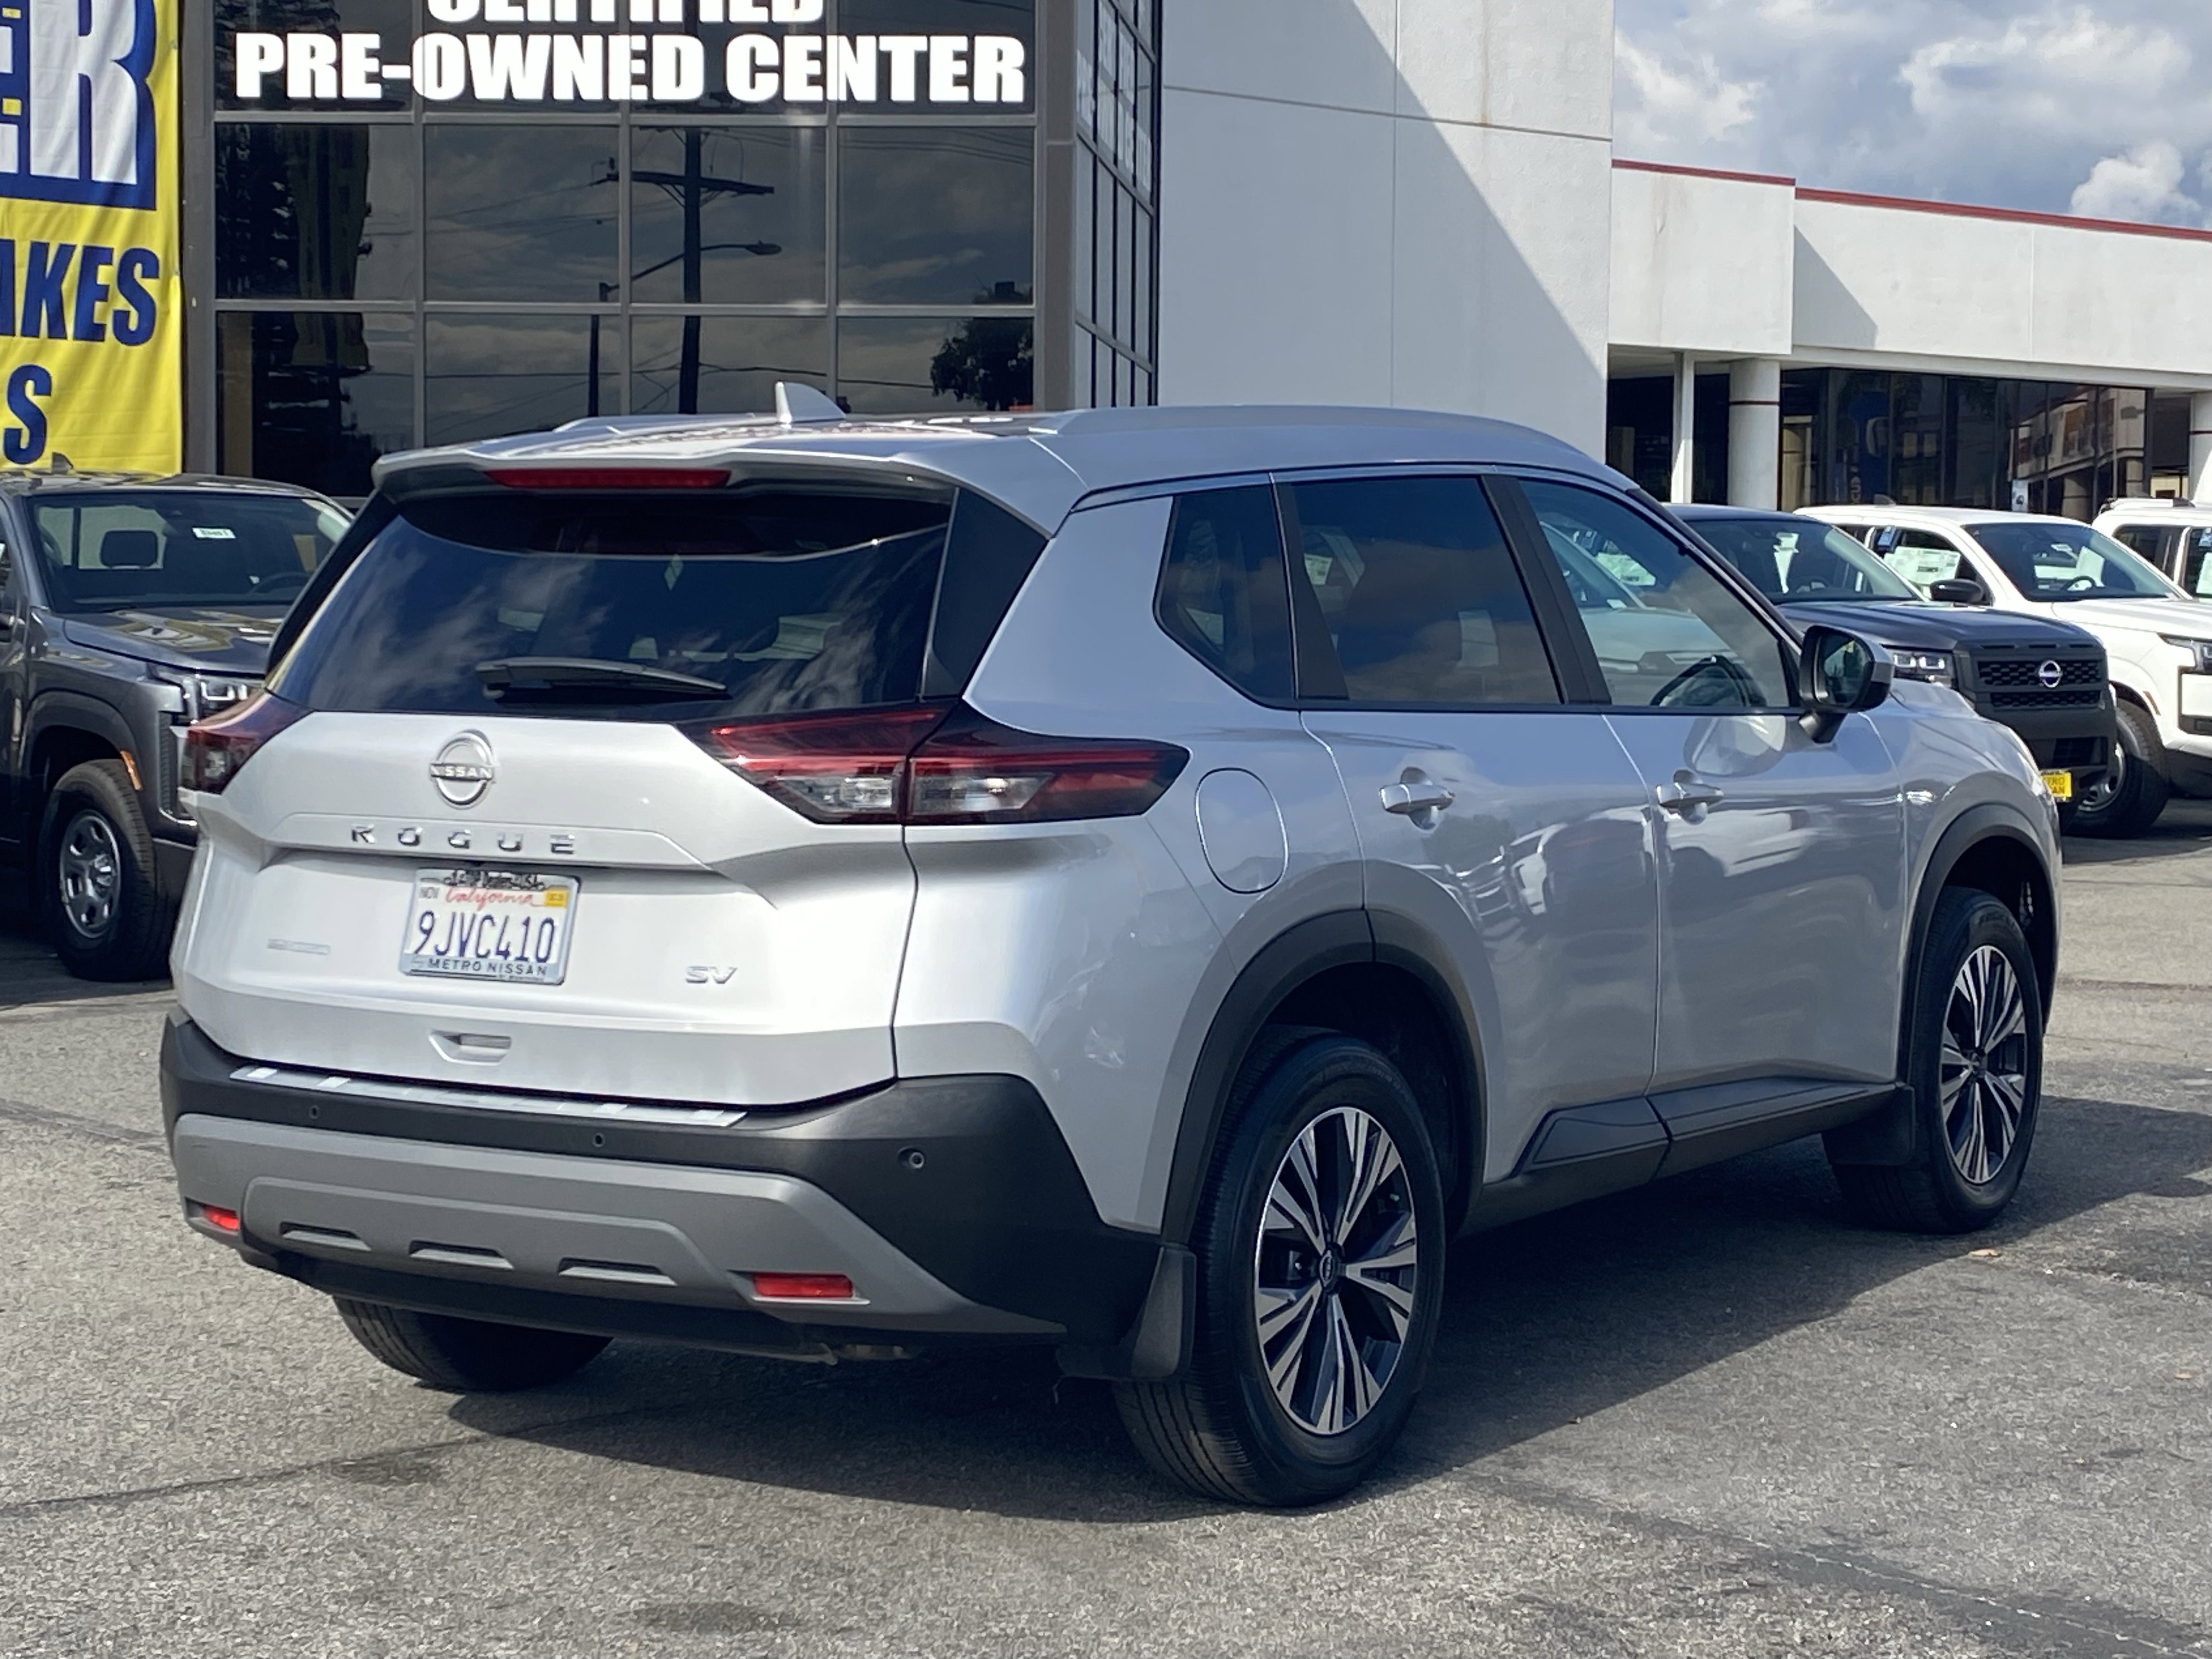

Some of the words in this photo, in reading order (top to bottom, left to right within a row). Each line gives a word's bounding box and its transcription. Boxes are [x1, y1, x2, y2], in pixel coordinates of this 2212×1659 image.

[235, 32, 705, 101] PRE-OWNED
[726, 34, 1024, 103] CENTER
[0, 0, 137, 184] R
[430, 765, 493, 778] NISSAN
[414, 910, 555, 963] 9JVC410
[427, 958, 482, 972] METRO
[487, 962, 548, 976] NISSAN
[686, 966, 738, 984] SV
